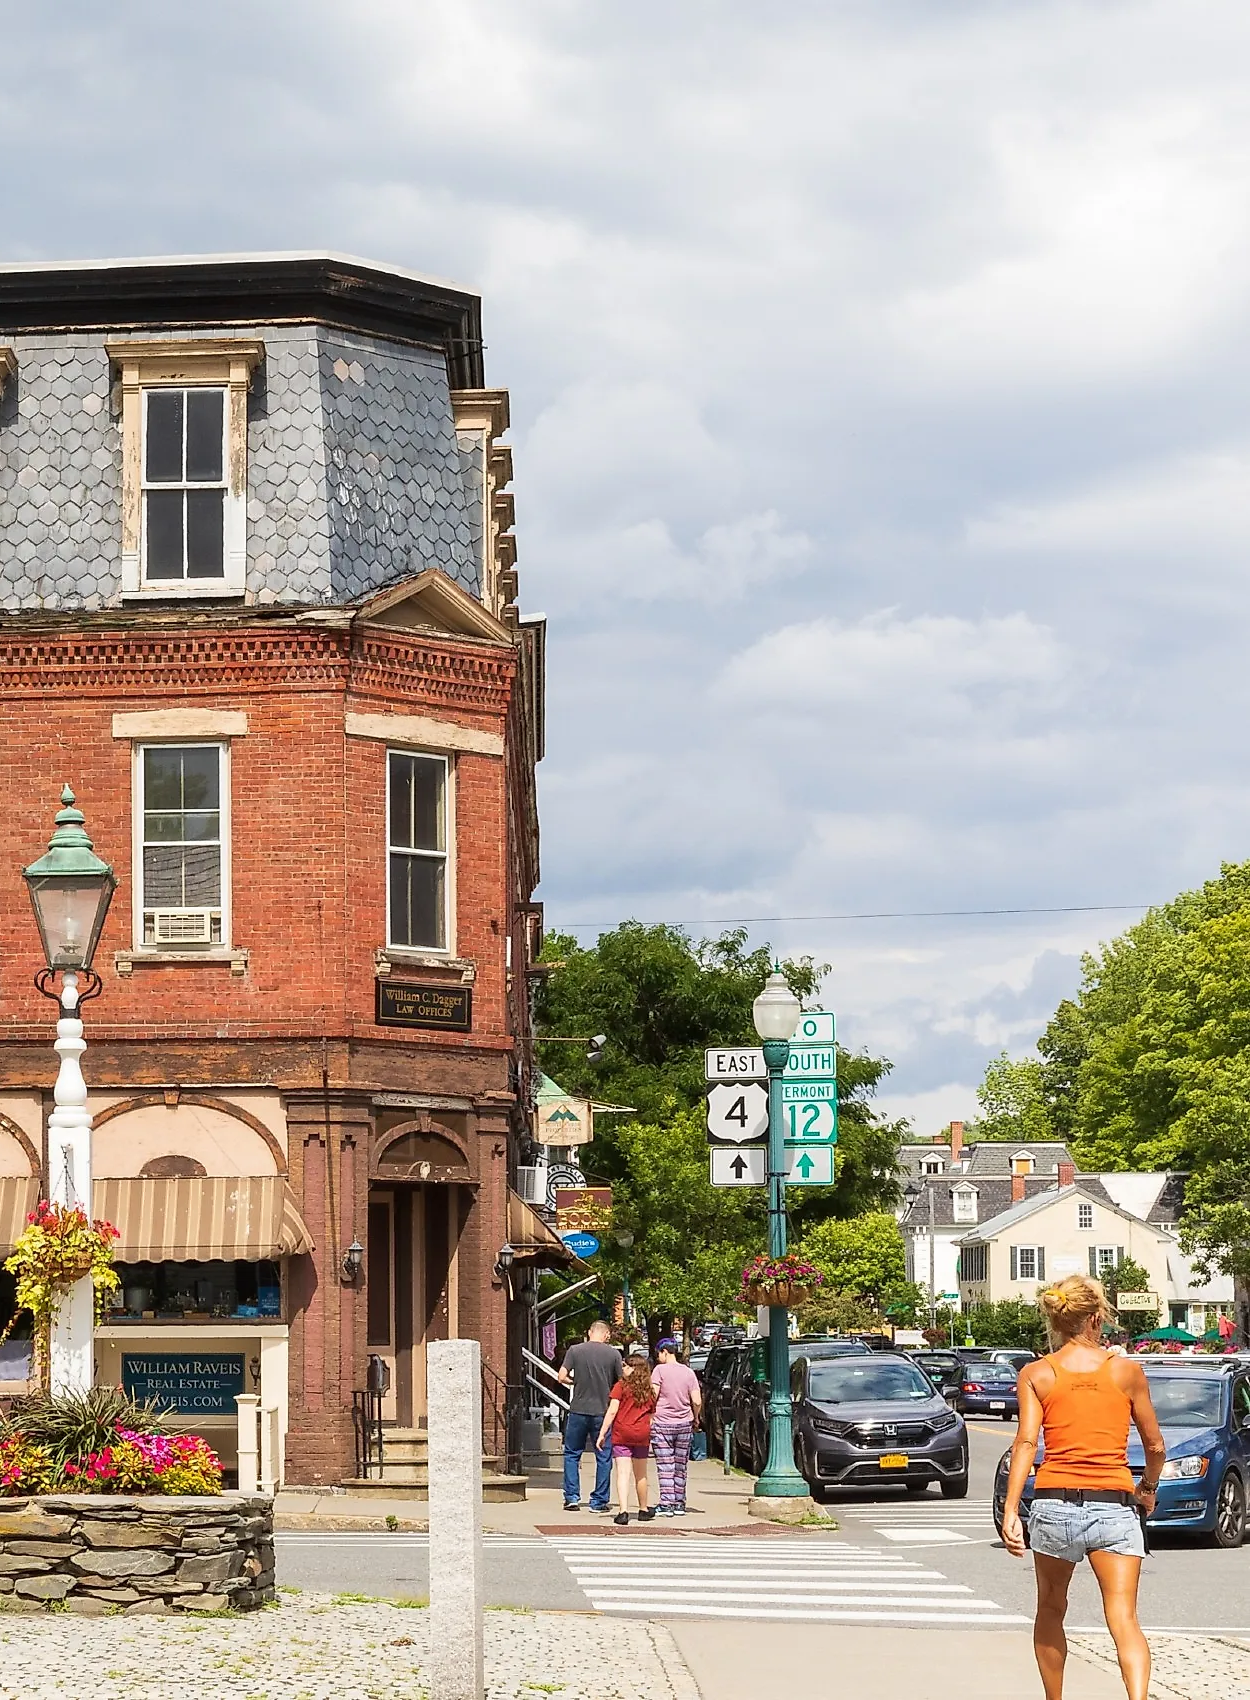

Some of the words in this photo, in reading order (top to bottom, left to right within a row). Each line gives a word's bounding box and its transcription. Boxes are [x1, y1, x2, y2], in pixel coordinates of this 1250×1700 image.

[385, 988, 419, 1002] William
[421, 992, 431, 1003] C.
[432, 993, 462, 1008] Dagger
[396, 1003, 414, 1014] LAW
[418, 1005, 452, 1017] OFFICES
[716, 1054, 757, 1072] EAST
[789, 1053, 831, 1071] OUTH
[782, 1085, 831, 1098] ERMONT
[724, 1096, 749, 1128] 4
[788, 1103, 821, 1137] 12
[127, 1361, 190, 1375] WILLIAM
[194, 1361, 241, 1375] RAVEIS
[147, 1378, 177, 1389] REAL
[179, 1378, 221, 1389] ESTATE
